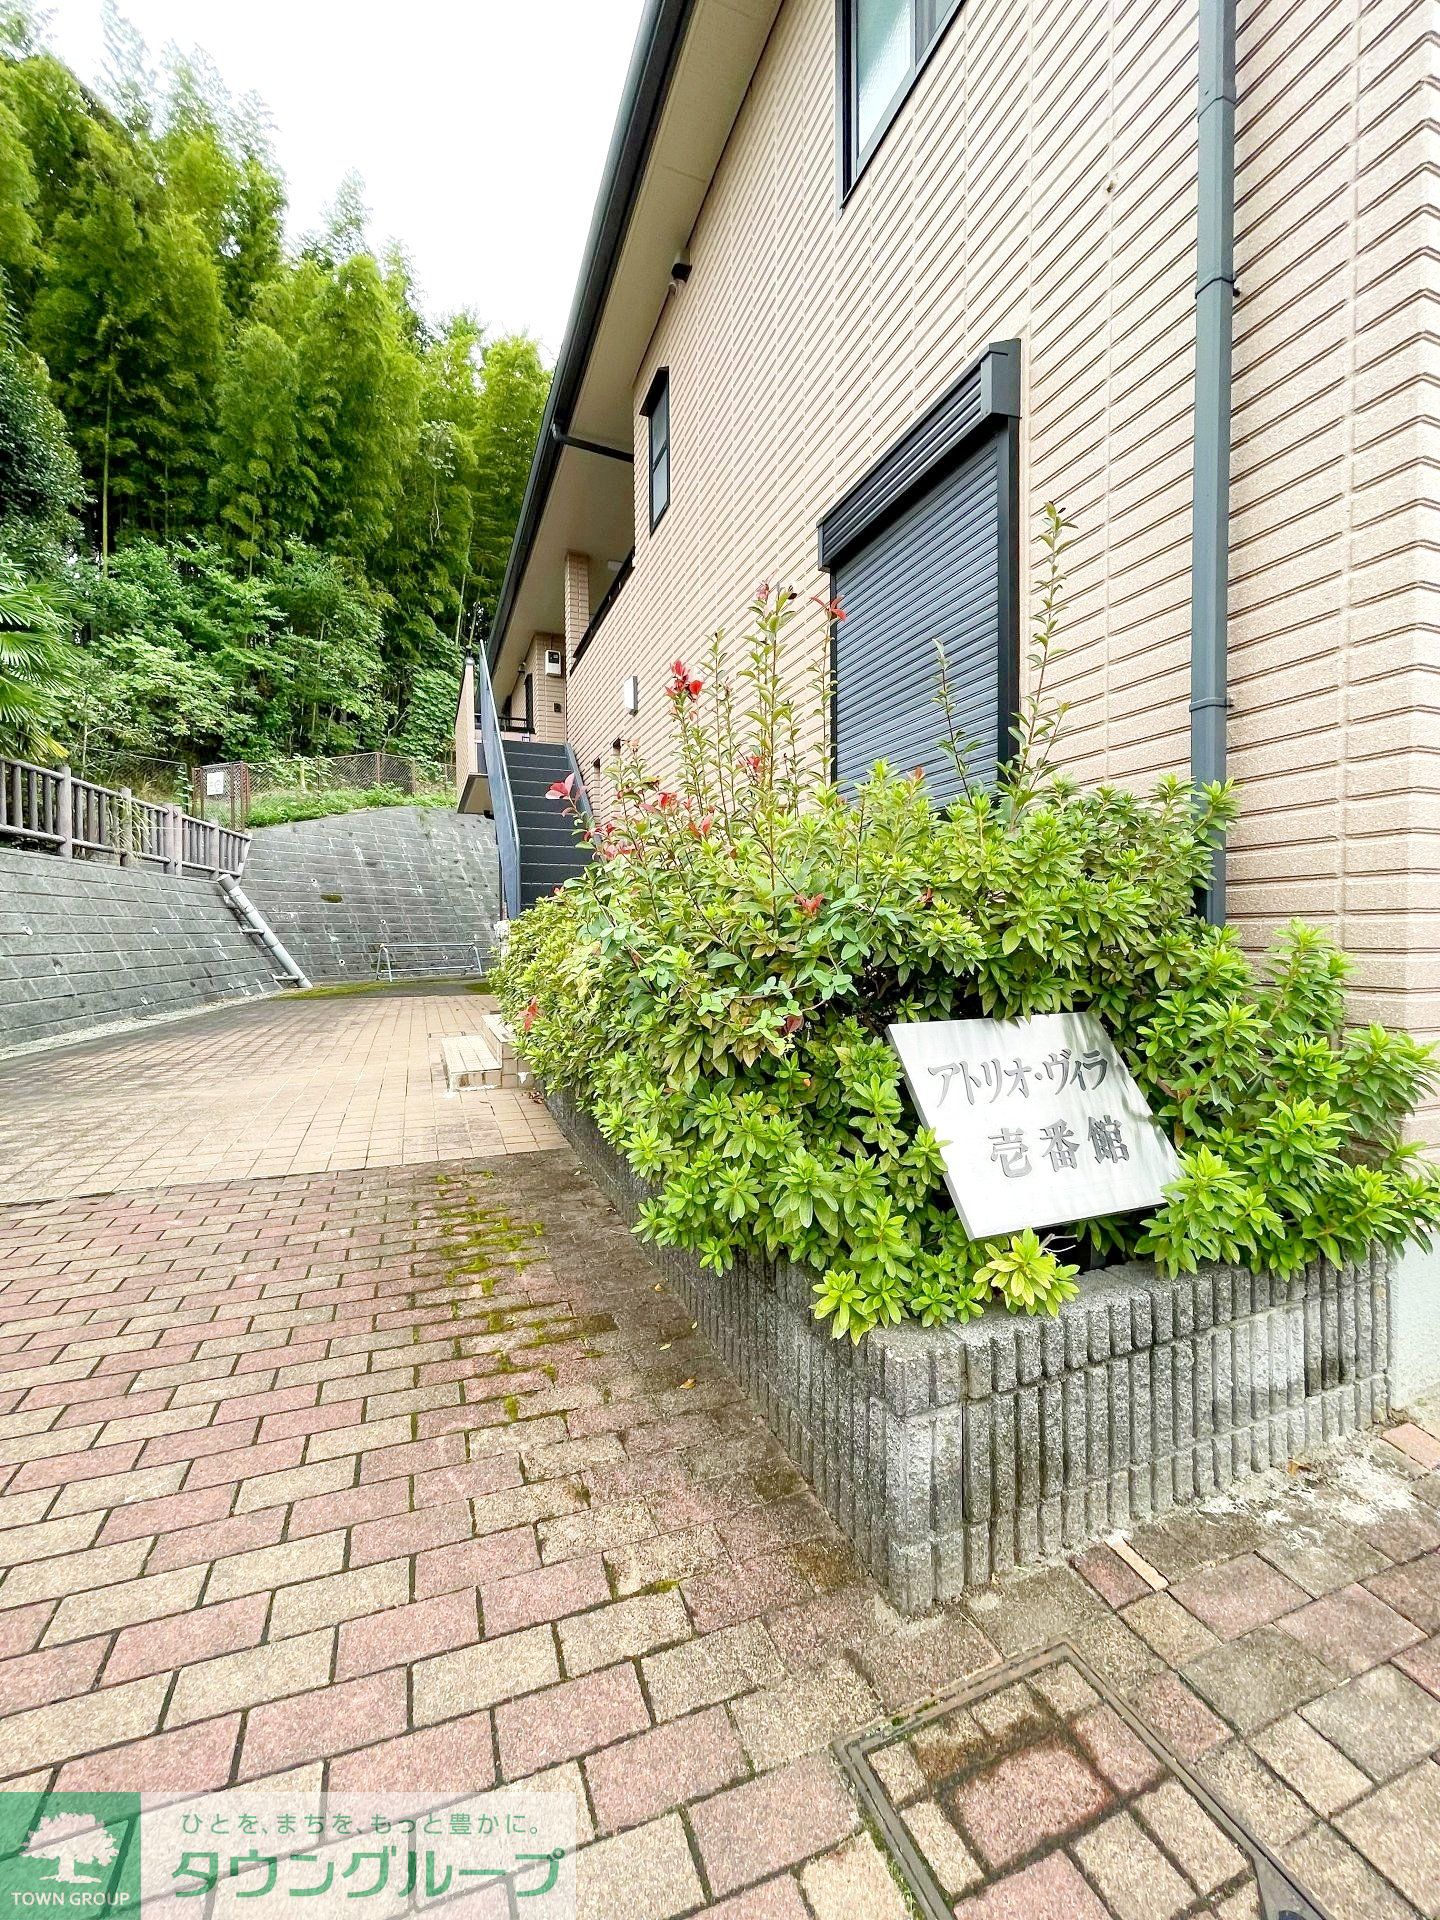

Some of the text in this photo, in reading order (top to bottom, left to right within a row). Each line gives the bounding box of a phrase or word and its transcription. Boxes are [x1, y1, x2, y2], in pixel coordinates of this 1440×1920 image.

[927, 1048, 1108, 1108] アトリオ・ヴィラ
